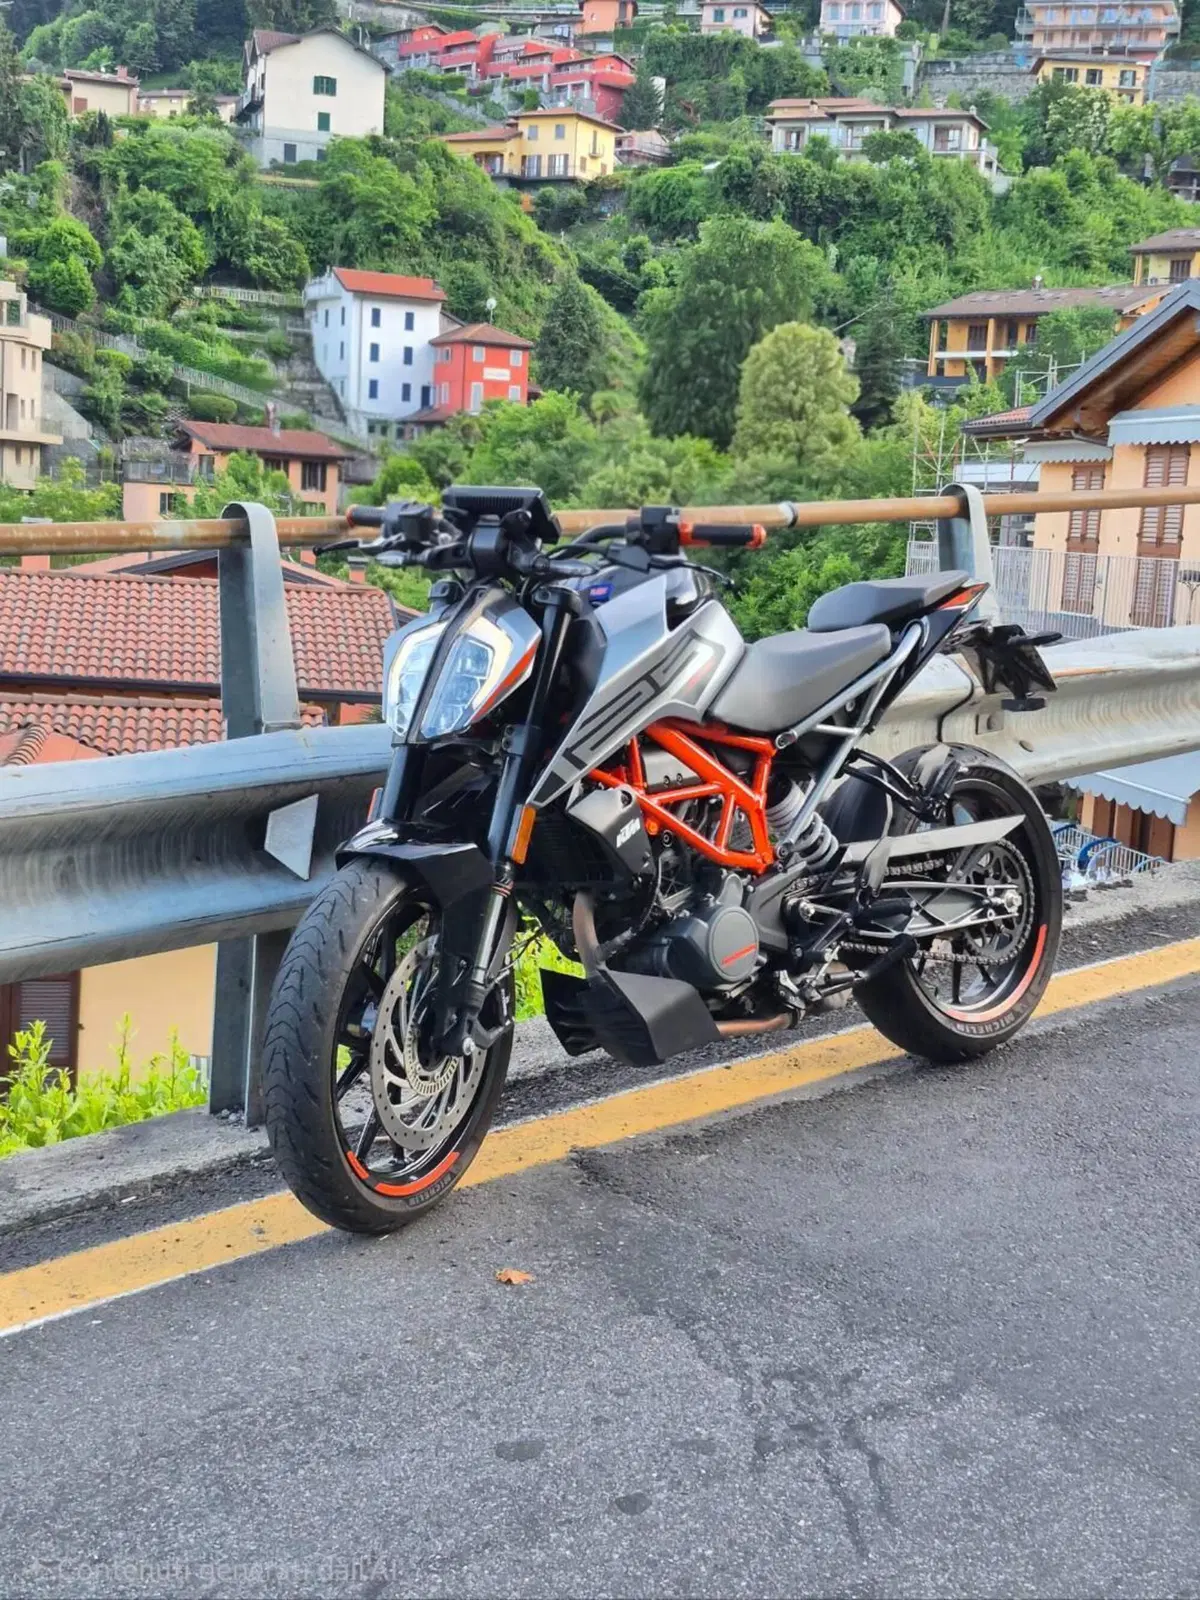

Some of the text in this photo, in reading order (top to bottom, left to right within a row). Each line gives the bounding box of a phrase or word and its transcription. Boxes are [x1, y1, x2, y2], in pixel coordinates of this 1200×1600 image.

[616, 817, 641, 849] KTM
[956, 1012, 1015, 1034] MICHELIN
[409, 1175, 452, 1206] MICHELIN
